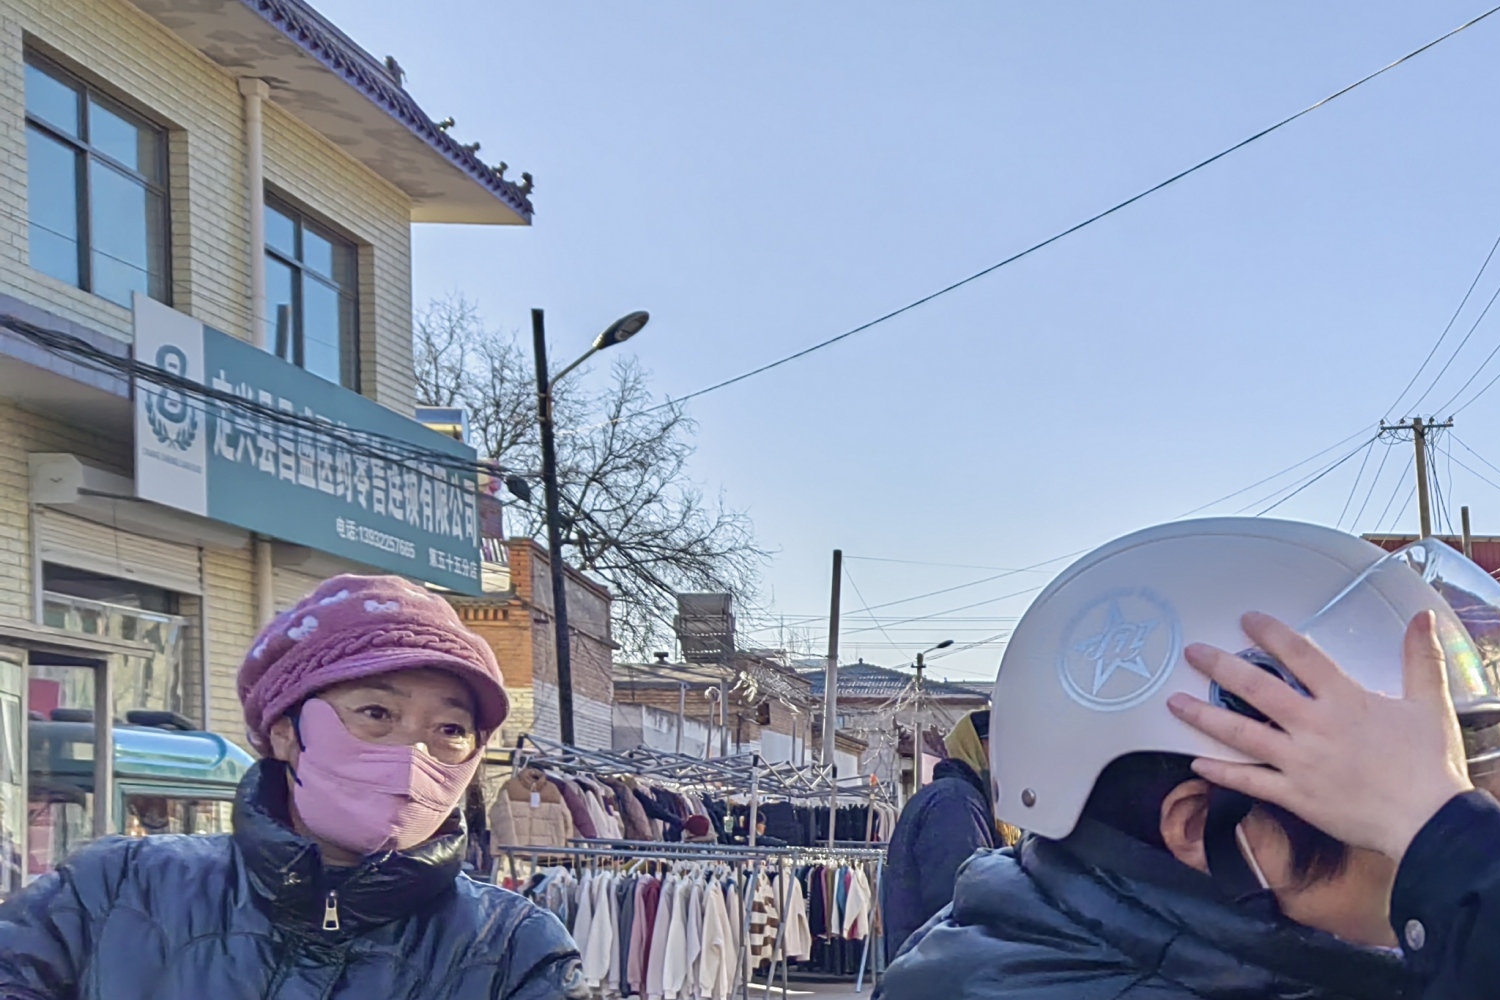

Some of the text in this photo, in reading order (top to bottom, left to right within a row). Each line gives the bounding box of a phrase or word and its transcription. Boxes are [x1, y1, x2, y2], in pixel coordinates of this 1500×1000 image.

[428, 547, 478, 580] 第五十五分店
